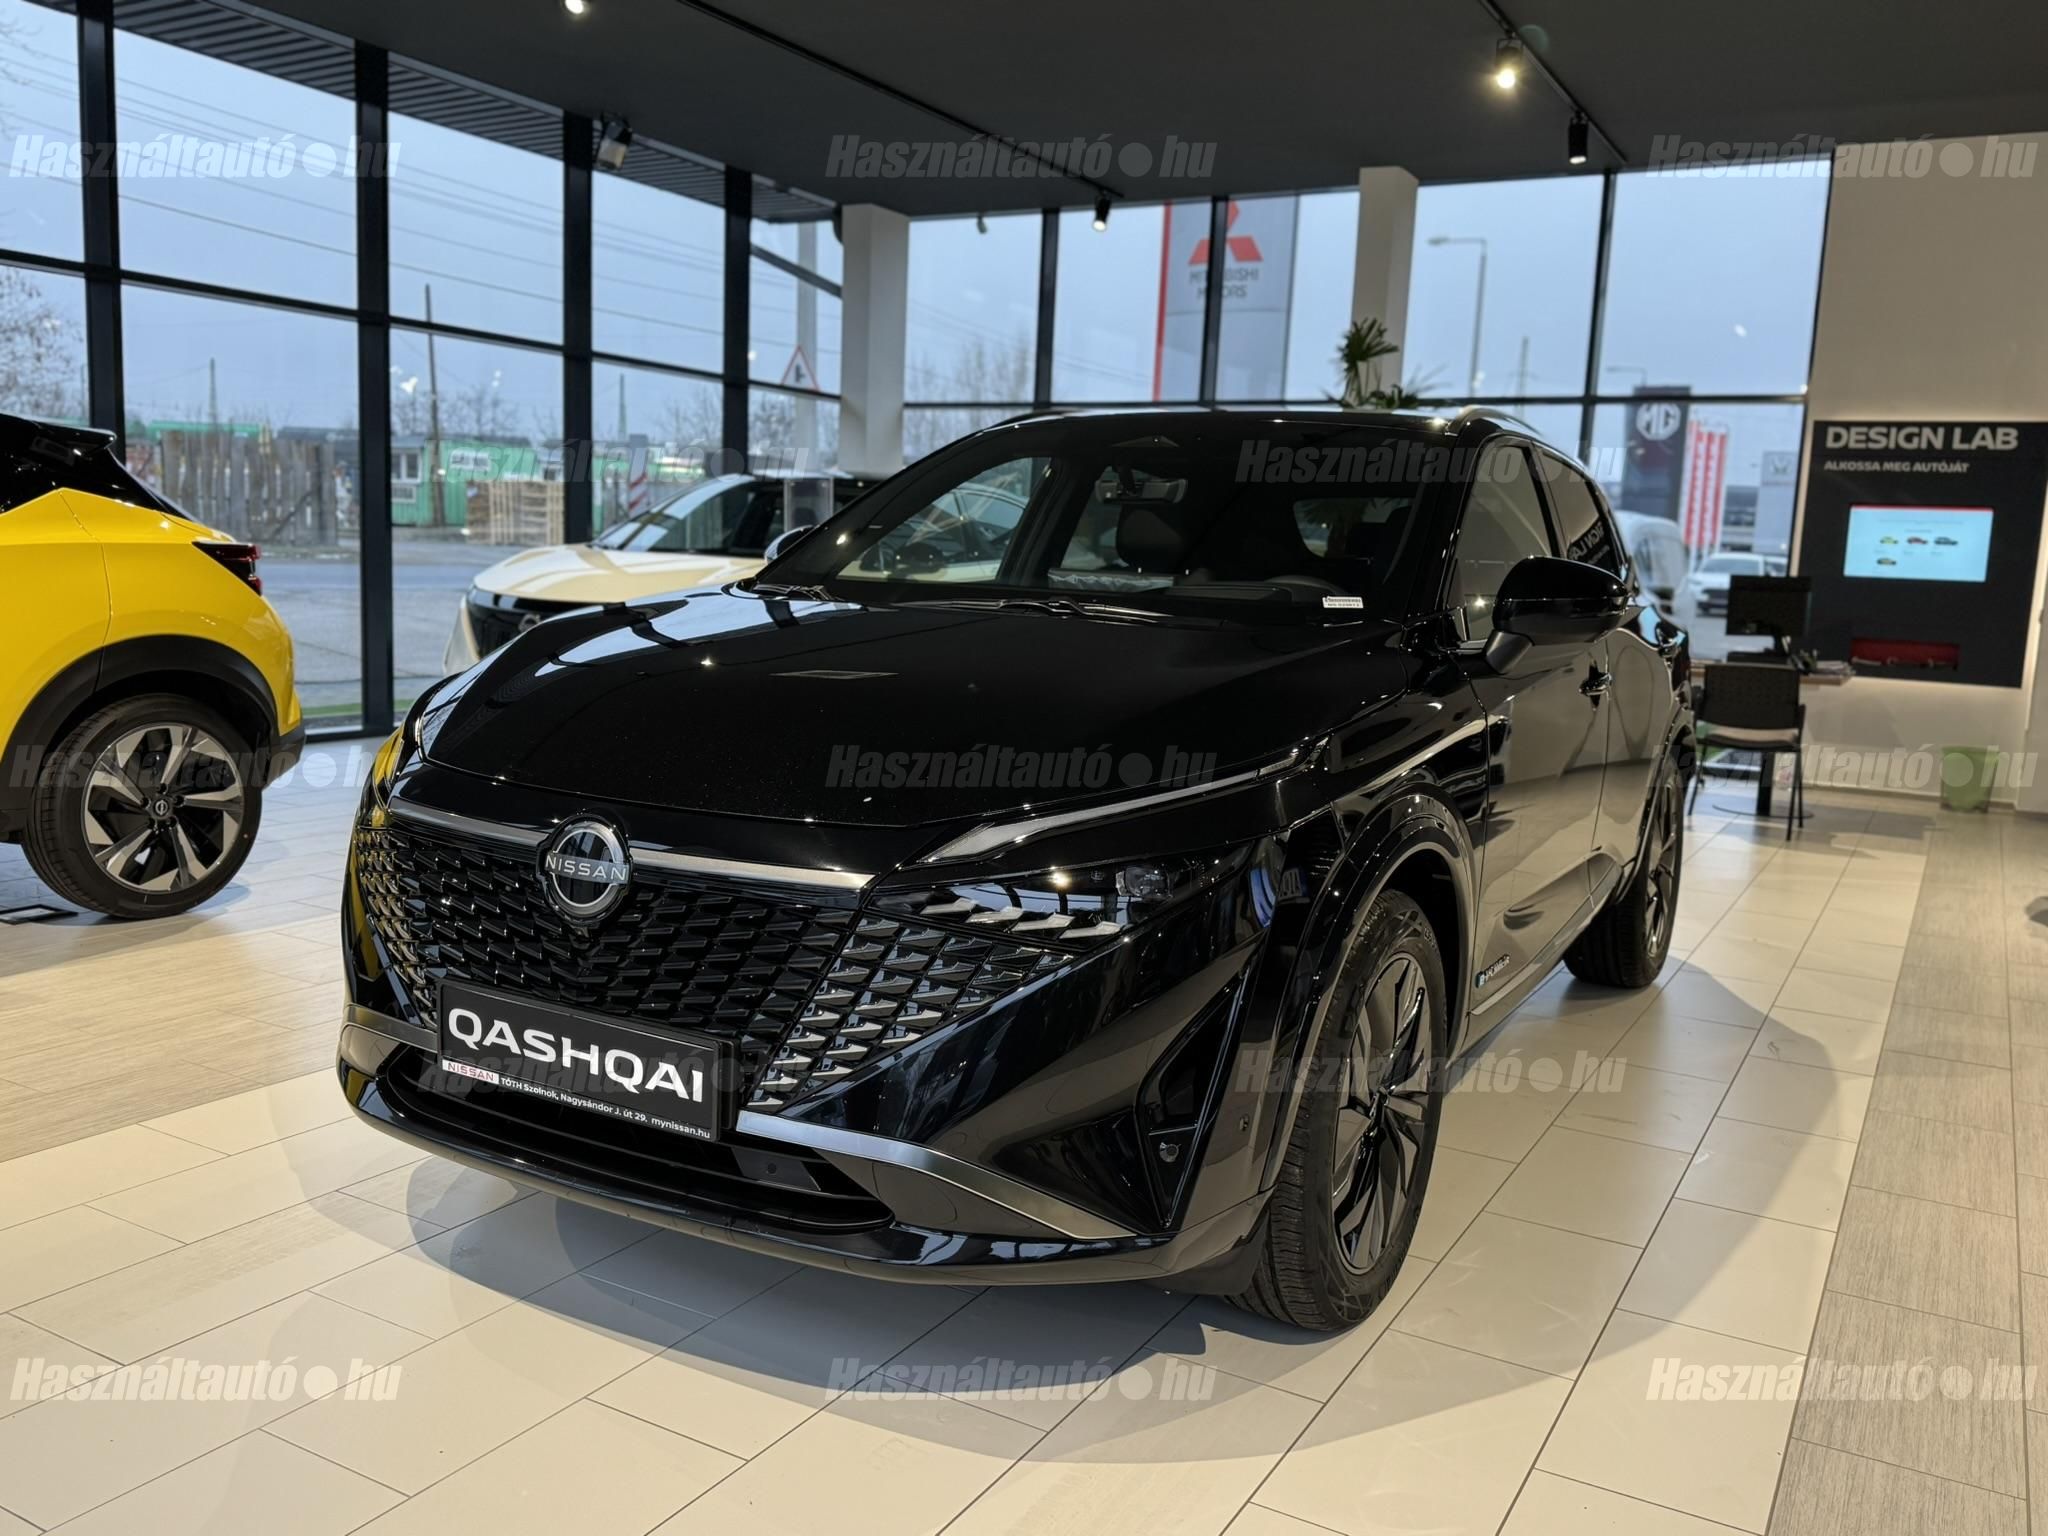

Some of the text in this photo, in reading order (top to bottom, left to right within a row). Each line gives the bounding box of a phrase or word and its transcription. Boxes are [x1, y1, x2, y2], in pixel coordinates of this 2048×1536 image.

[1636, 402, 1681, 441] MG
[1825, 426, 2019, 450] DESIGN LAB
[1824, 459, 1970, 473] ALKOSSA MEG AUTÓJÁT
[545, 854, 627, 881] NISSAN
[448, 1008, 704, 1103] QASHQAI
[447, 1061, 495, 1082] NISSAN
[501, 1076, 523, 1091] TÓTH
[524, 1082, 559, 1100] Szolnok,
[560, 1093, 613, 1114] Nagysándor
[634, 1112, 648, 1123] 29.
[651, 1117, 711, 1139] mynissan.hu
